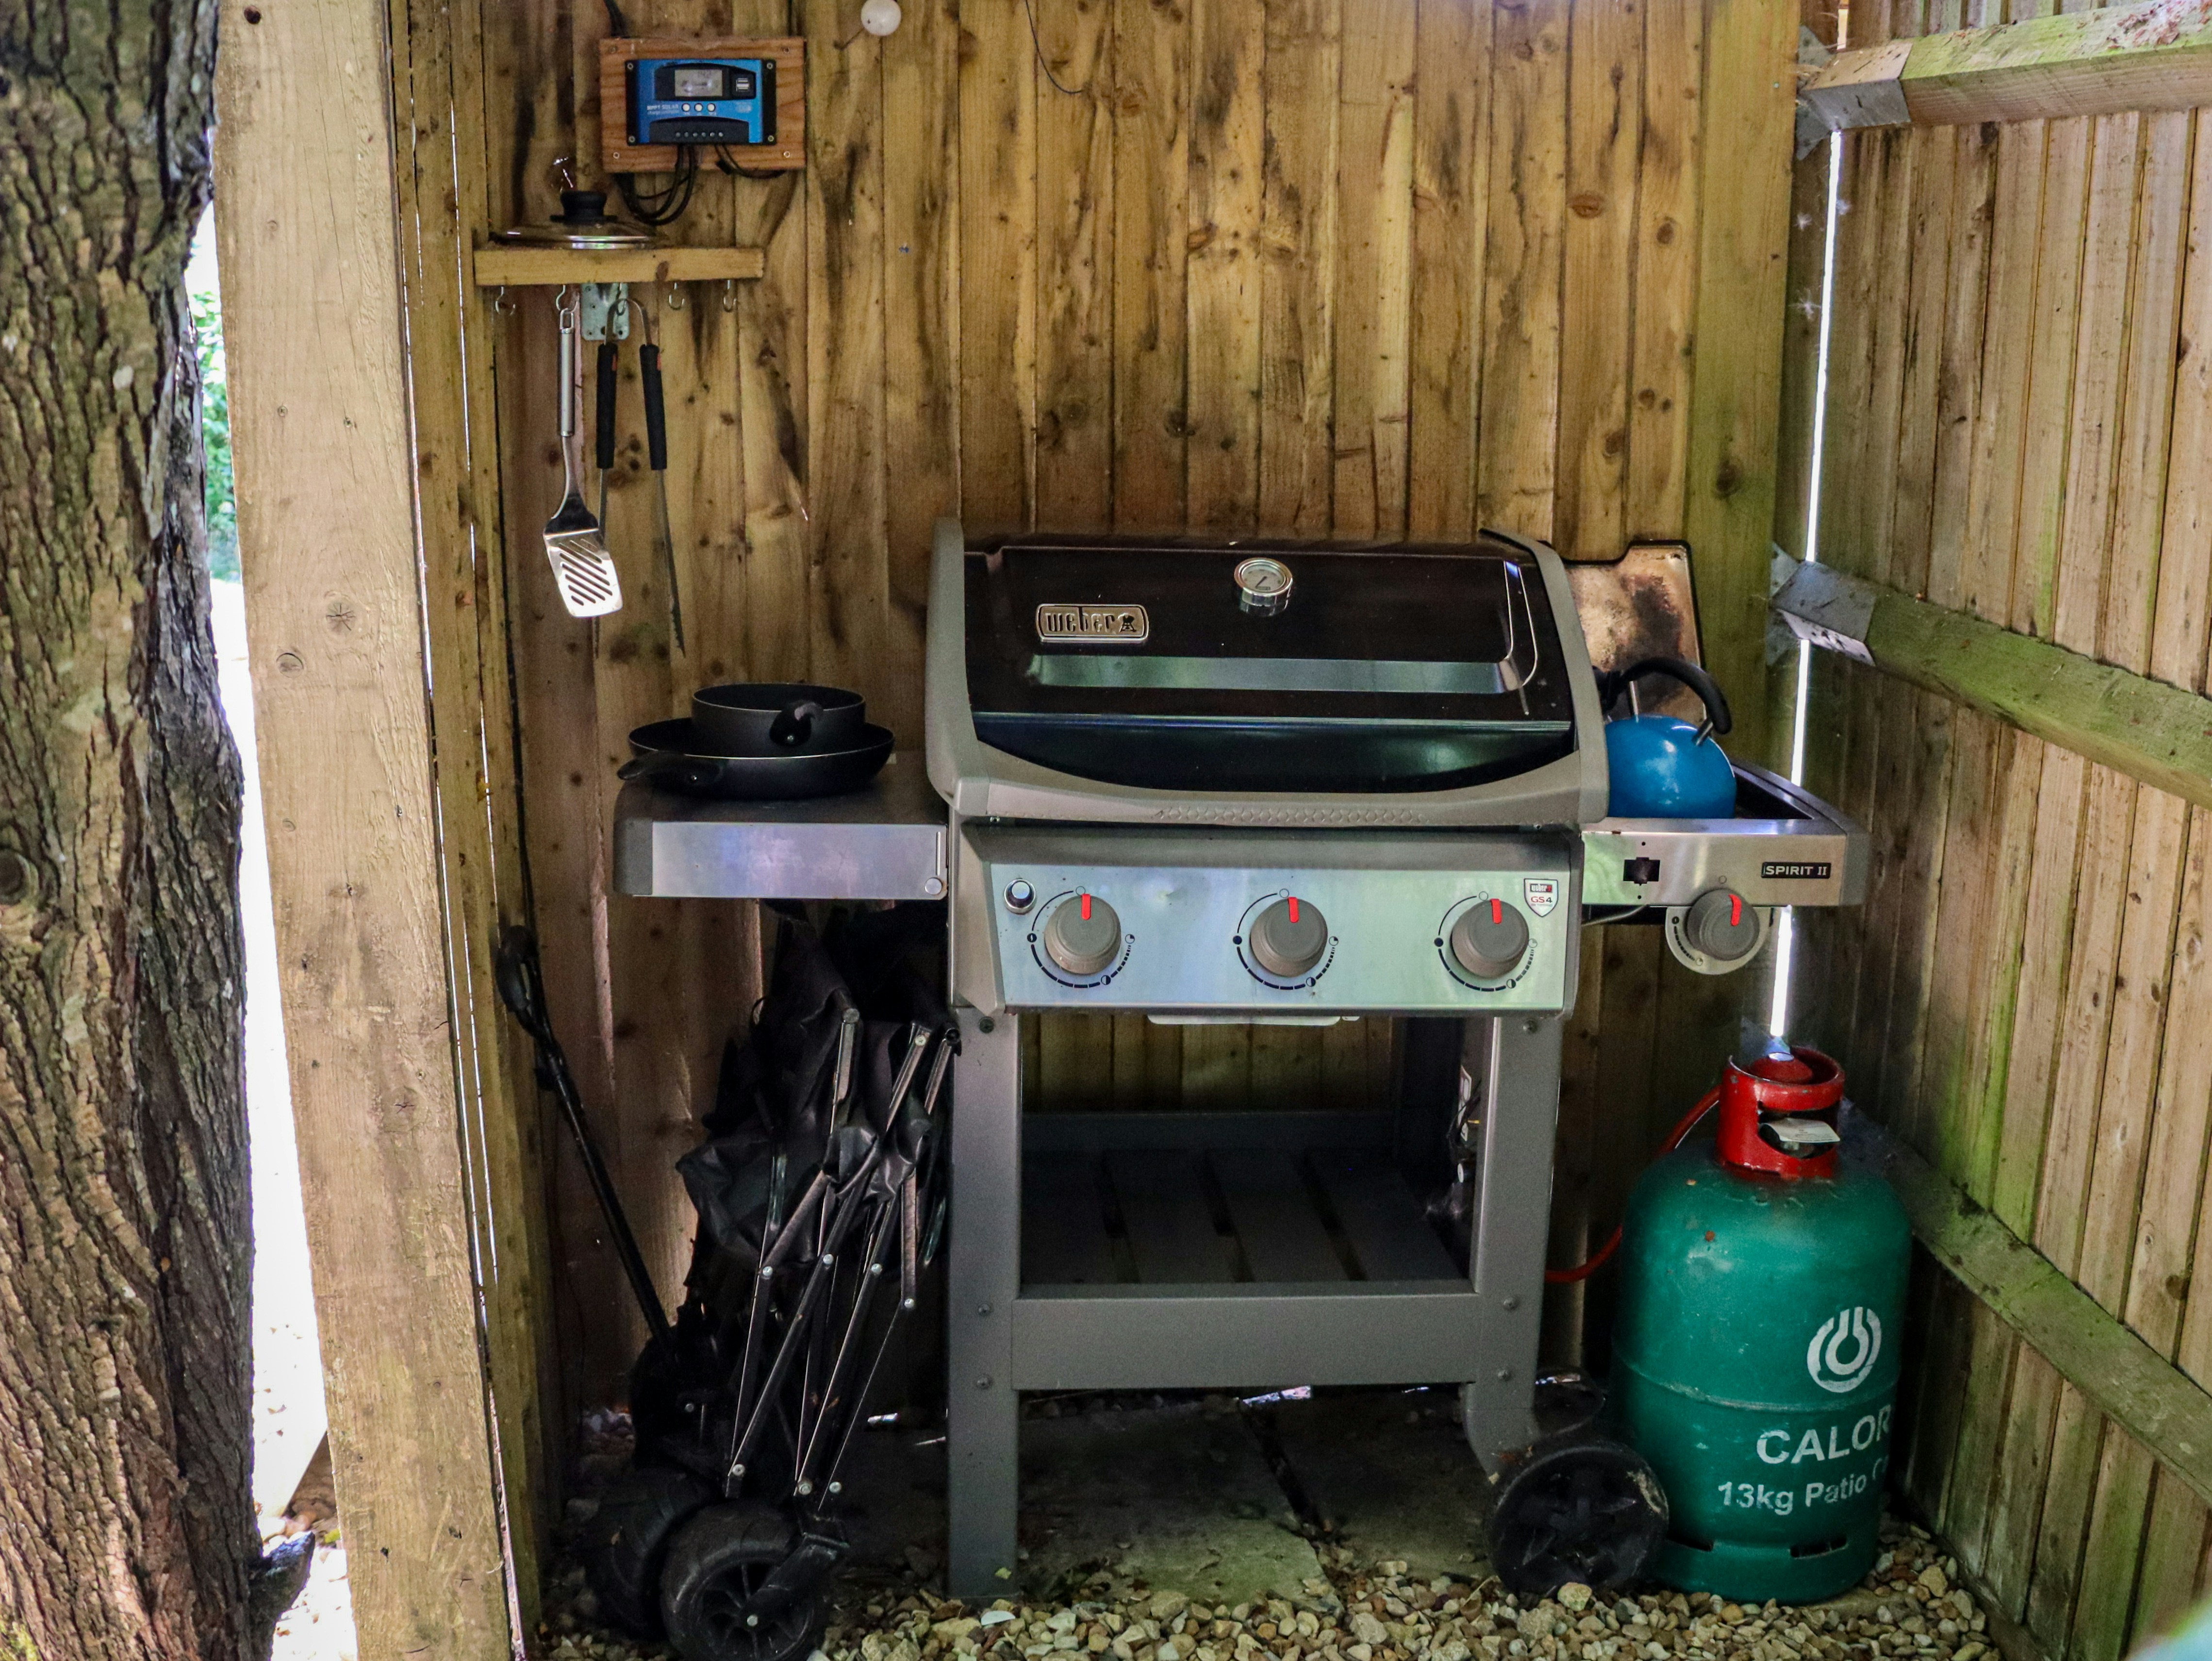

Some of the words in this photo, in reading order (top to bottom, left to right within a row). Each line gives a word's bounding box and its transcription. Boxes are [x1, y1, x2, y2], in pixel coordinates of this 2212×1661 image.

[1765, 865, 1814, 876] SPIRIT
[1817, 866, 1827, 876] II
[1756, 1404, 1891, 1464] CALOR
[1718, 1481, 1794, 1516] 13kg
[1805, 1473, 1867, 1508] Patio
